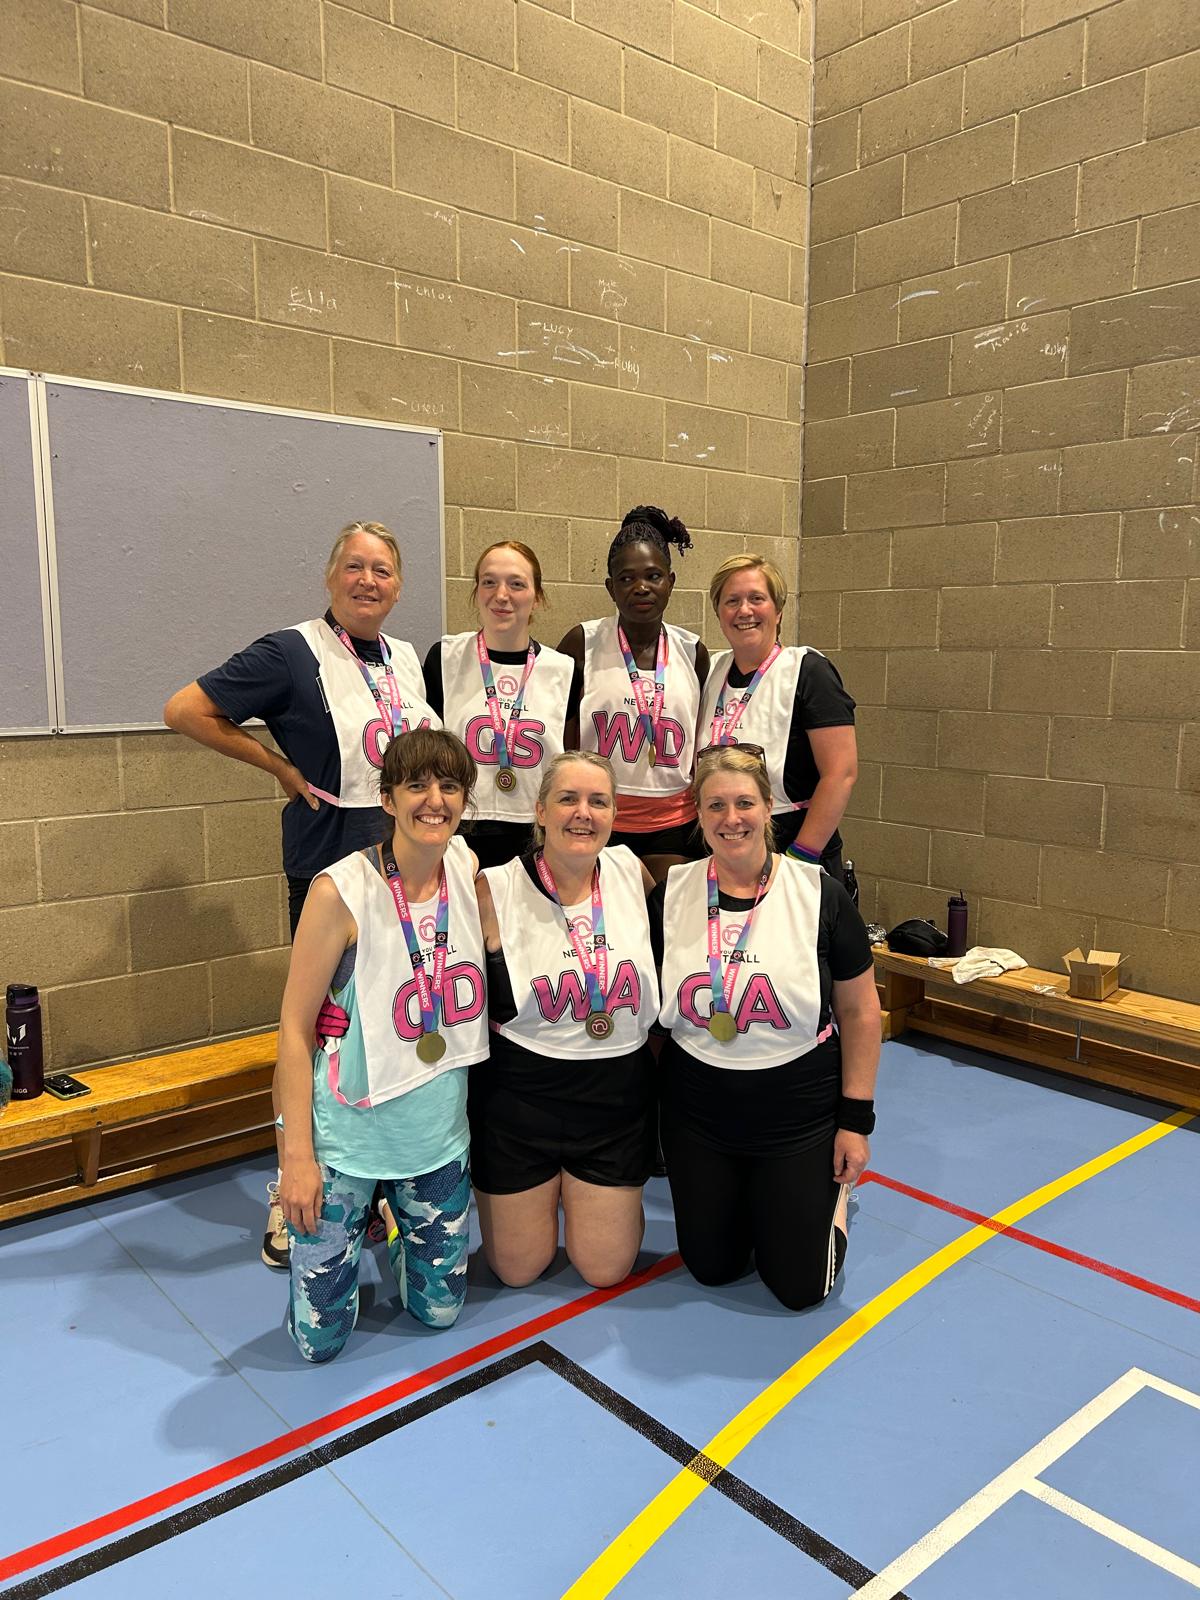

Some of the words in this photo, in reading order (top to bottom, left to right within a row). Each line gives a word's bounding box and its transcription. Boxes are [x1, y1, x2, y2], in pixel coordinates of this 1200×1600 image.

[490, 700, 503, 731] WINNERS
[465, 715, 546, 769] GS
[506, 722, 517, 754] WINNERS
[592, 711, 686, 768] WD
[392, 880, 408, 919] WINNERS
[572, 934, 592, 970] WINNERS
[711, 921, 719, 956] WINNERS
[433, 951, 445, 990] WINNERS
[598, 953, 606, 990] WINNERS
[416, 971, 431, 1008] WINNERS
[530, 960, 641, 1023] WA
